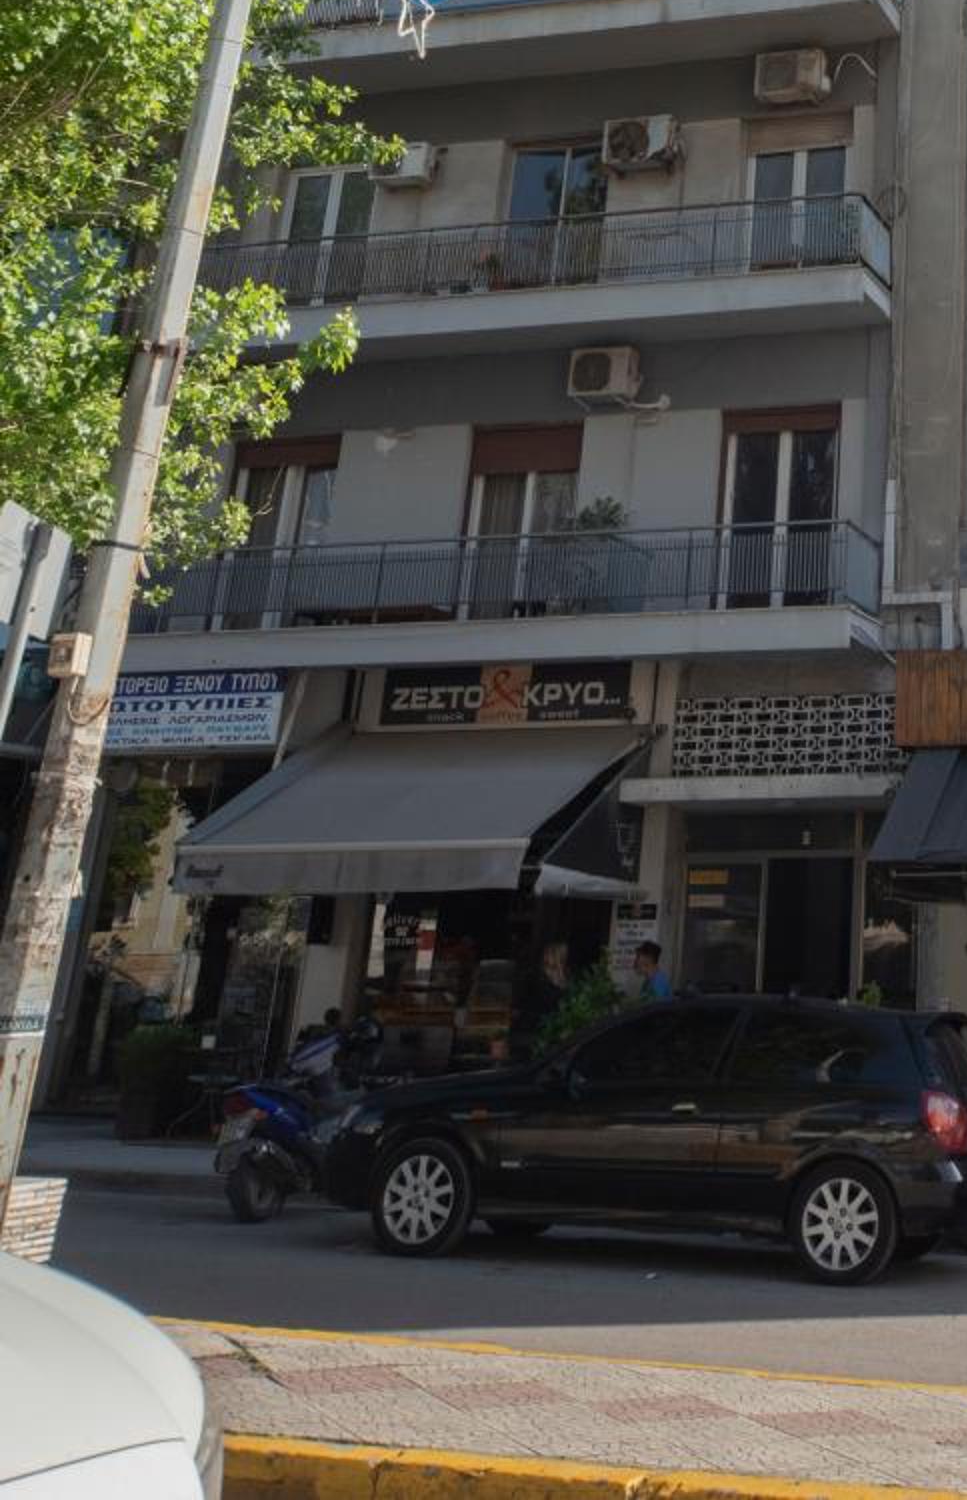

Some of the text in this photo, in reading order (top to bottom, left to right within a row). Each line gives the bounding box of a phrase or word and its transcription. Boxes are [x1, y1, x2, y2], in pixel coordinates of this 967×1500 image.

[116, 673, 279, 694] ΤΟΡΕΙΟ ΞΕΝΟΥ ΤΥΠΟΥ
[110, 696, 273, 713] ΩΤΟΤΥΠΙΕΣ
[391, 685, 482, 711] ΖΕΣΤΟ
